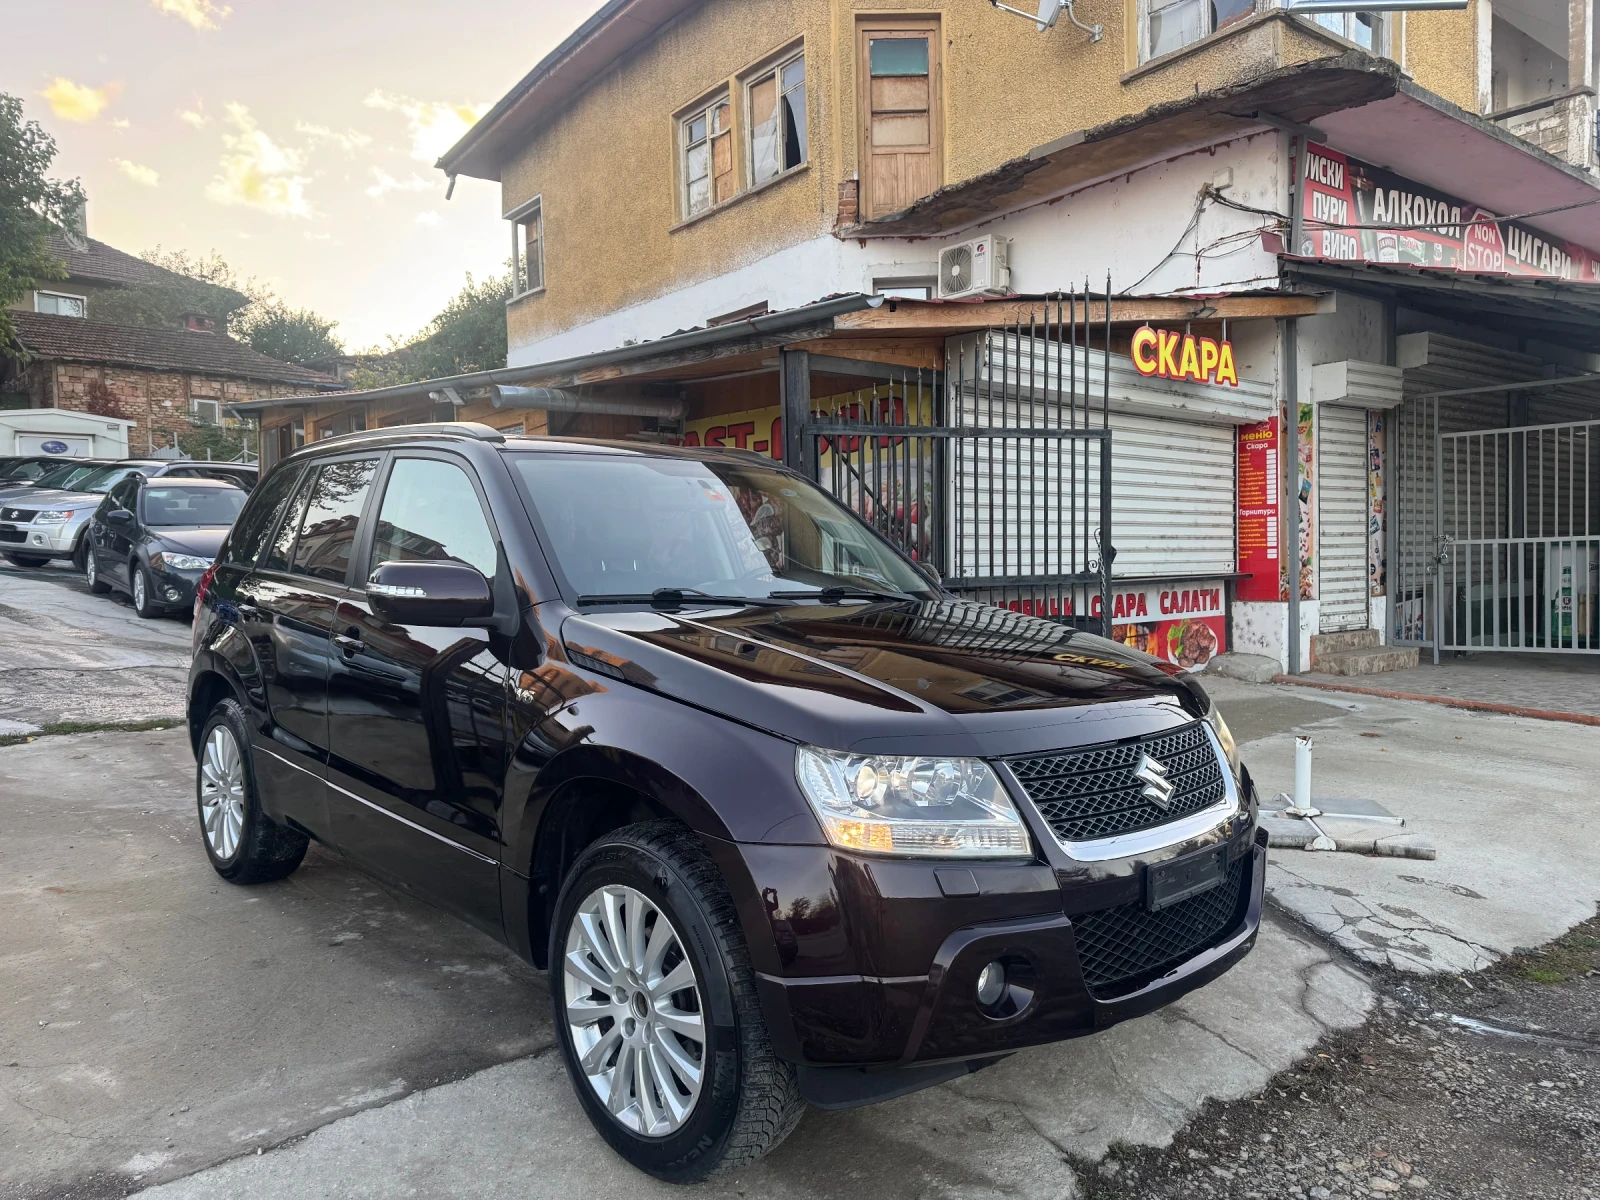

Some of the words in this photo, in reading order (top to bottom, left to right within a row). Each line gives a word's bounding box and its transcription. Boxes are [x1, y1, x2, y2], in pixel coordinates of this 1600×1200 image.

[1313, 190, 1347, 226] ПУРИ
[1373, 187, 1461, 238] АЛКОХОЛ
[1322, 230, 1357, 261] ВИНО
[1474, 224, 1496, 245] NON
[1468, 242, 1500, 271] STOP
[1507, 225, 1571, 280] ЦИГАРИ
[1131, 326, 1239, 387] СКАРА
[1091, 592, 1148, 619] САРА
[1160, 588, 1220, 614] САЛАТИ
